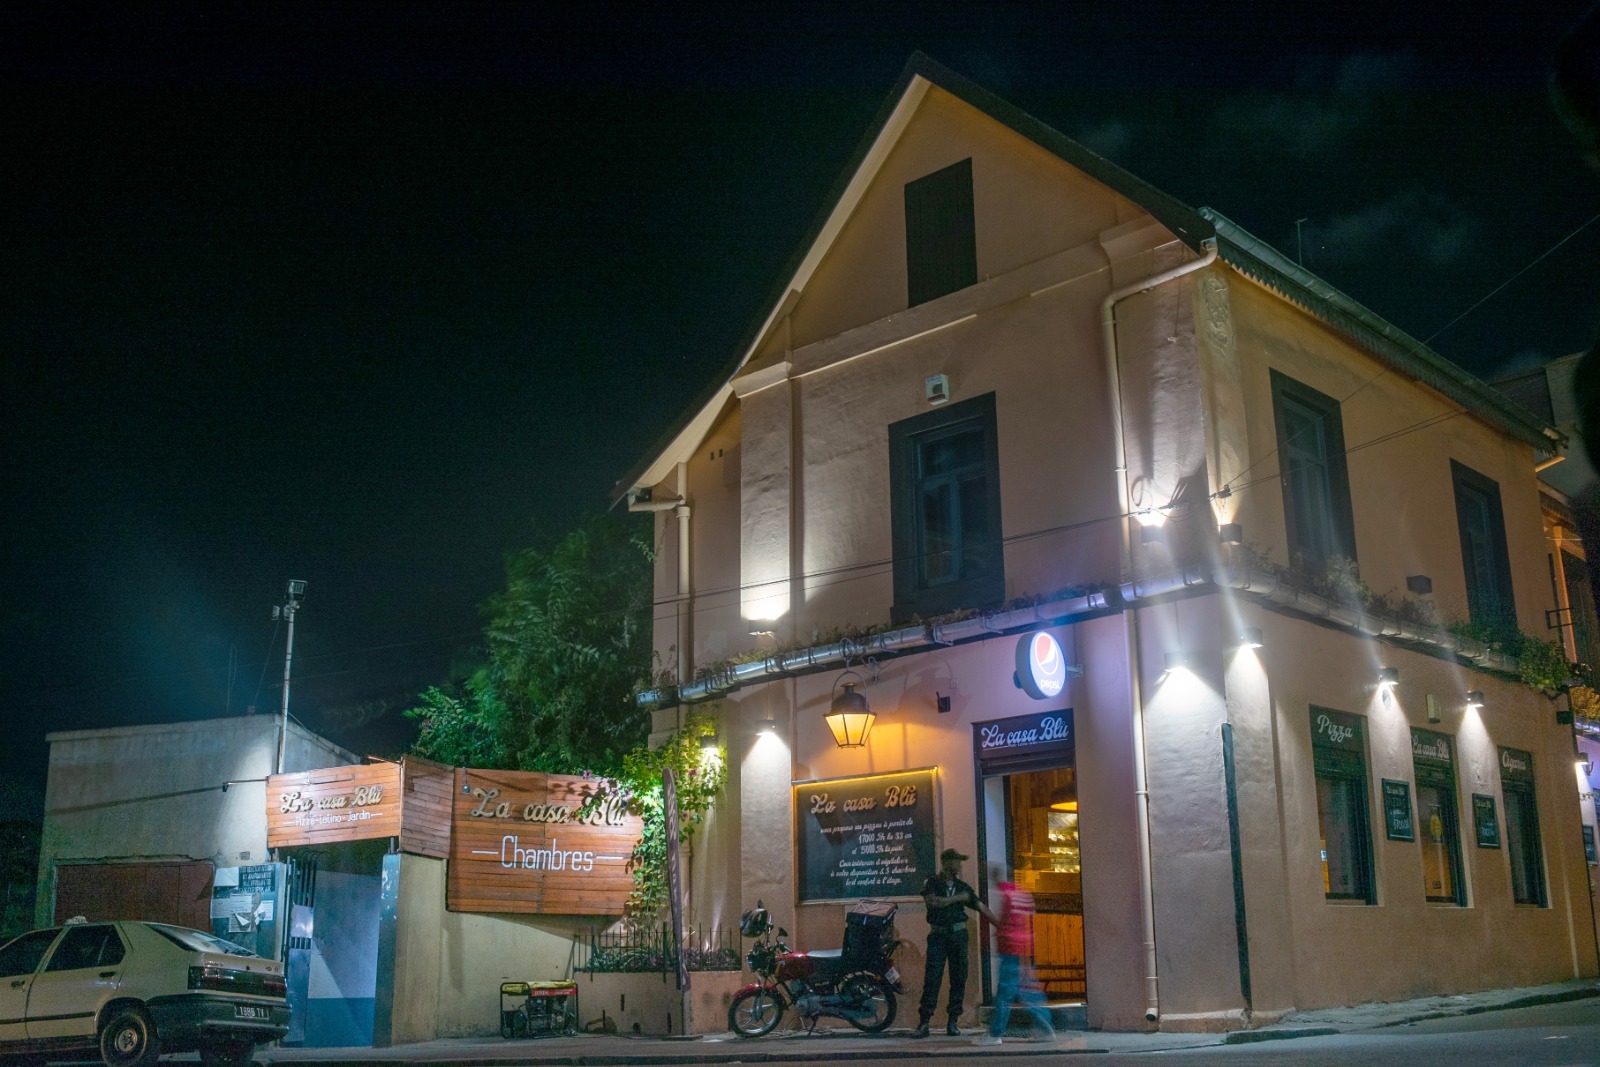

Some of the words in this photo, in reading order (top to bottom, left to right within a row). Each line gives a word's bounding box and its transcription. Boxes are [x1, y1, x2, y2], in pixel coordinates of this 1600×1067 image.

[1040, 679, 1060, 691] pepsi
[980, 725, 1006, 748] La
[1007, 728, 1038, 744] casa
[1317, 715, 1353, 742] Pizza
[280, 792, 312, 813] La
[318, 795, 349, 809] casa
[470, 787, 511, 818] La
[523, 803, 571, 823] casa
[810, 793, 837, 814] La
[843, 796, 876, 812] casa
[296, 816, 315, 826] Pizza
[319, 813, 342, 824] Latino
[348, 809, 371, 821] Jardin
[501, 835, 593, 871] Chambres
